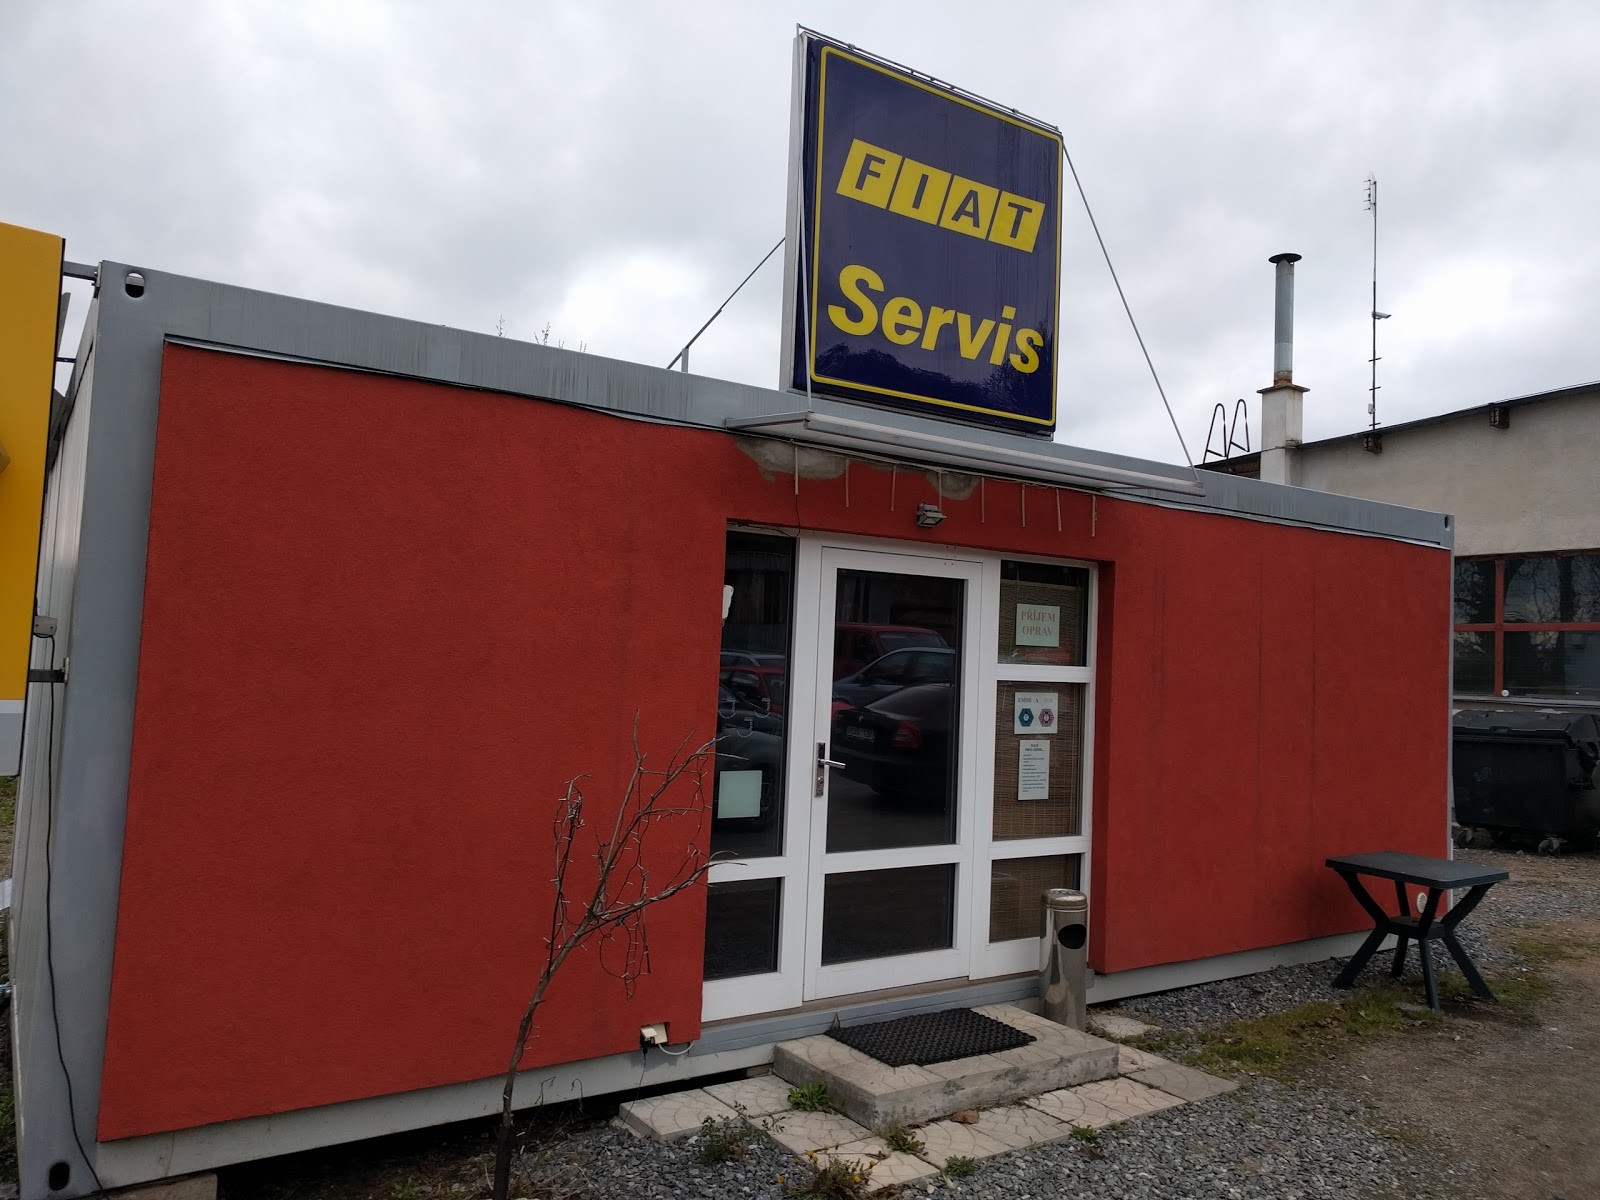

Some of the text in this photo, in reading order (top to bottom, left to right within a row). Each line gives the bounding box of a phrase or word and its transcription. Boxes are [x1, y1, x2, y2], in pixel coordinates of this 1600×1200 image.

[854, 152, 1033, 239] FIAT
[827, 263, 1044, 374] Servis
[1022, 625, 1054, 636] OPRAV
